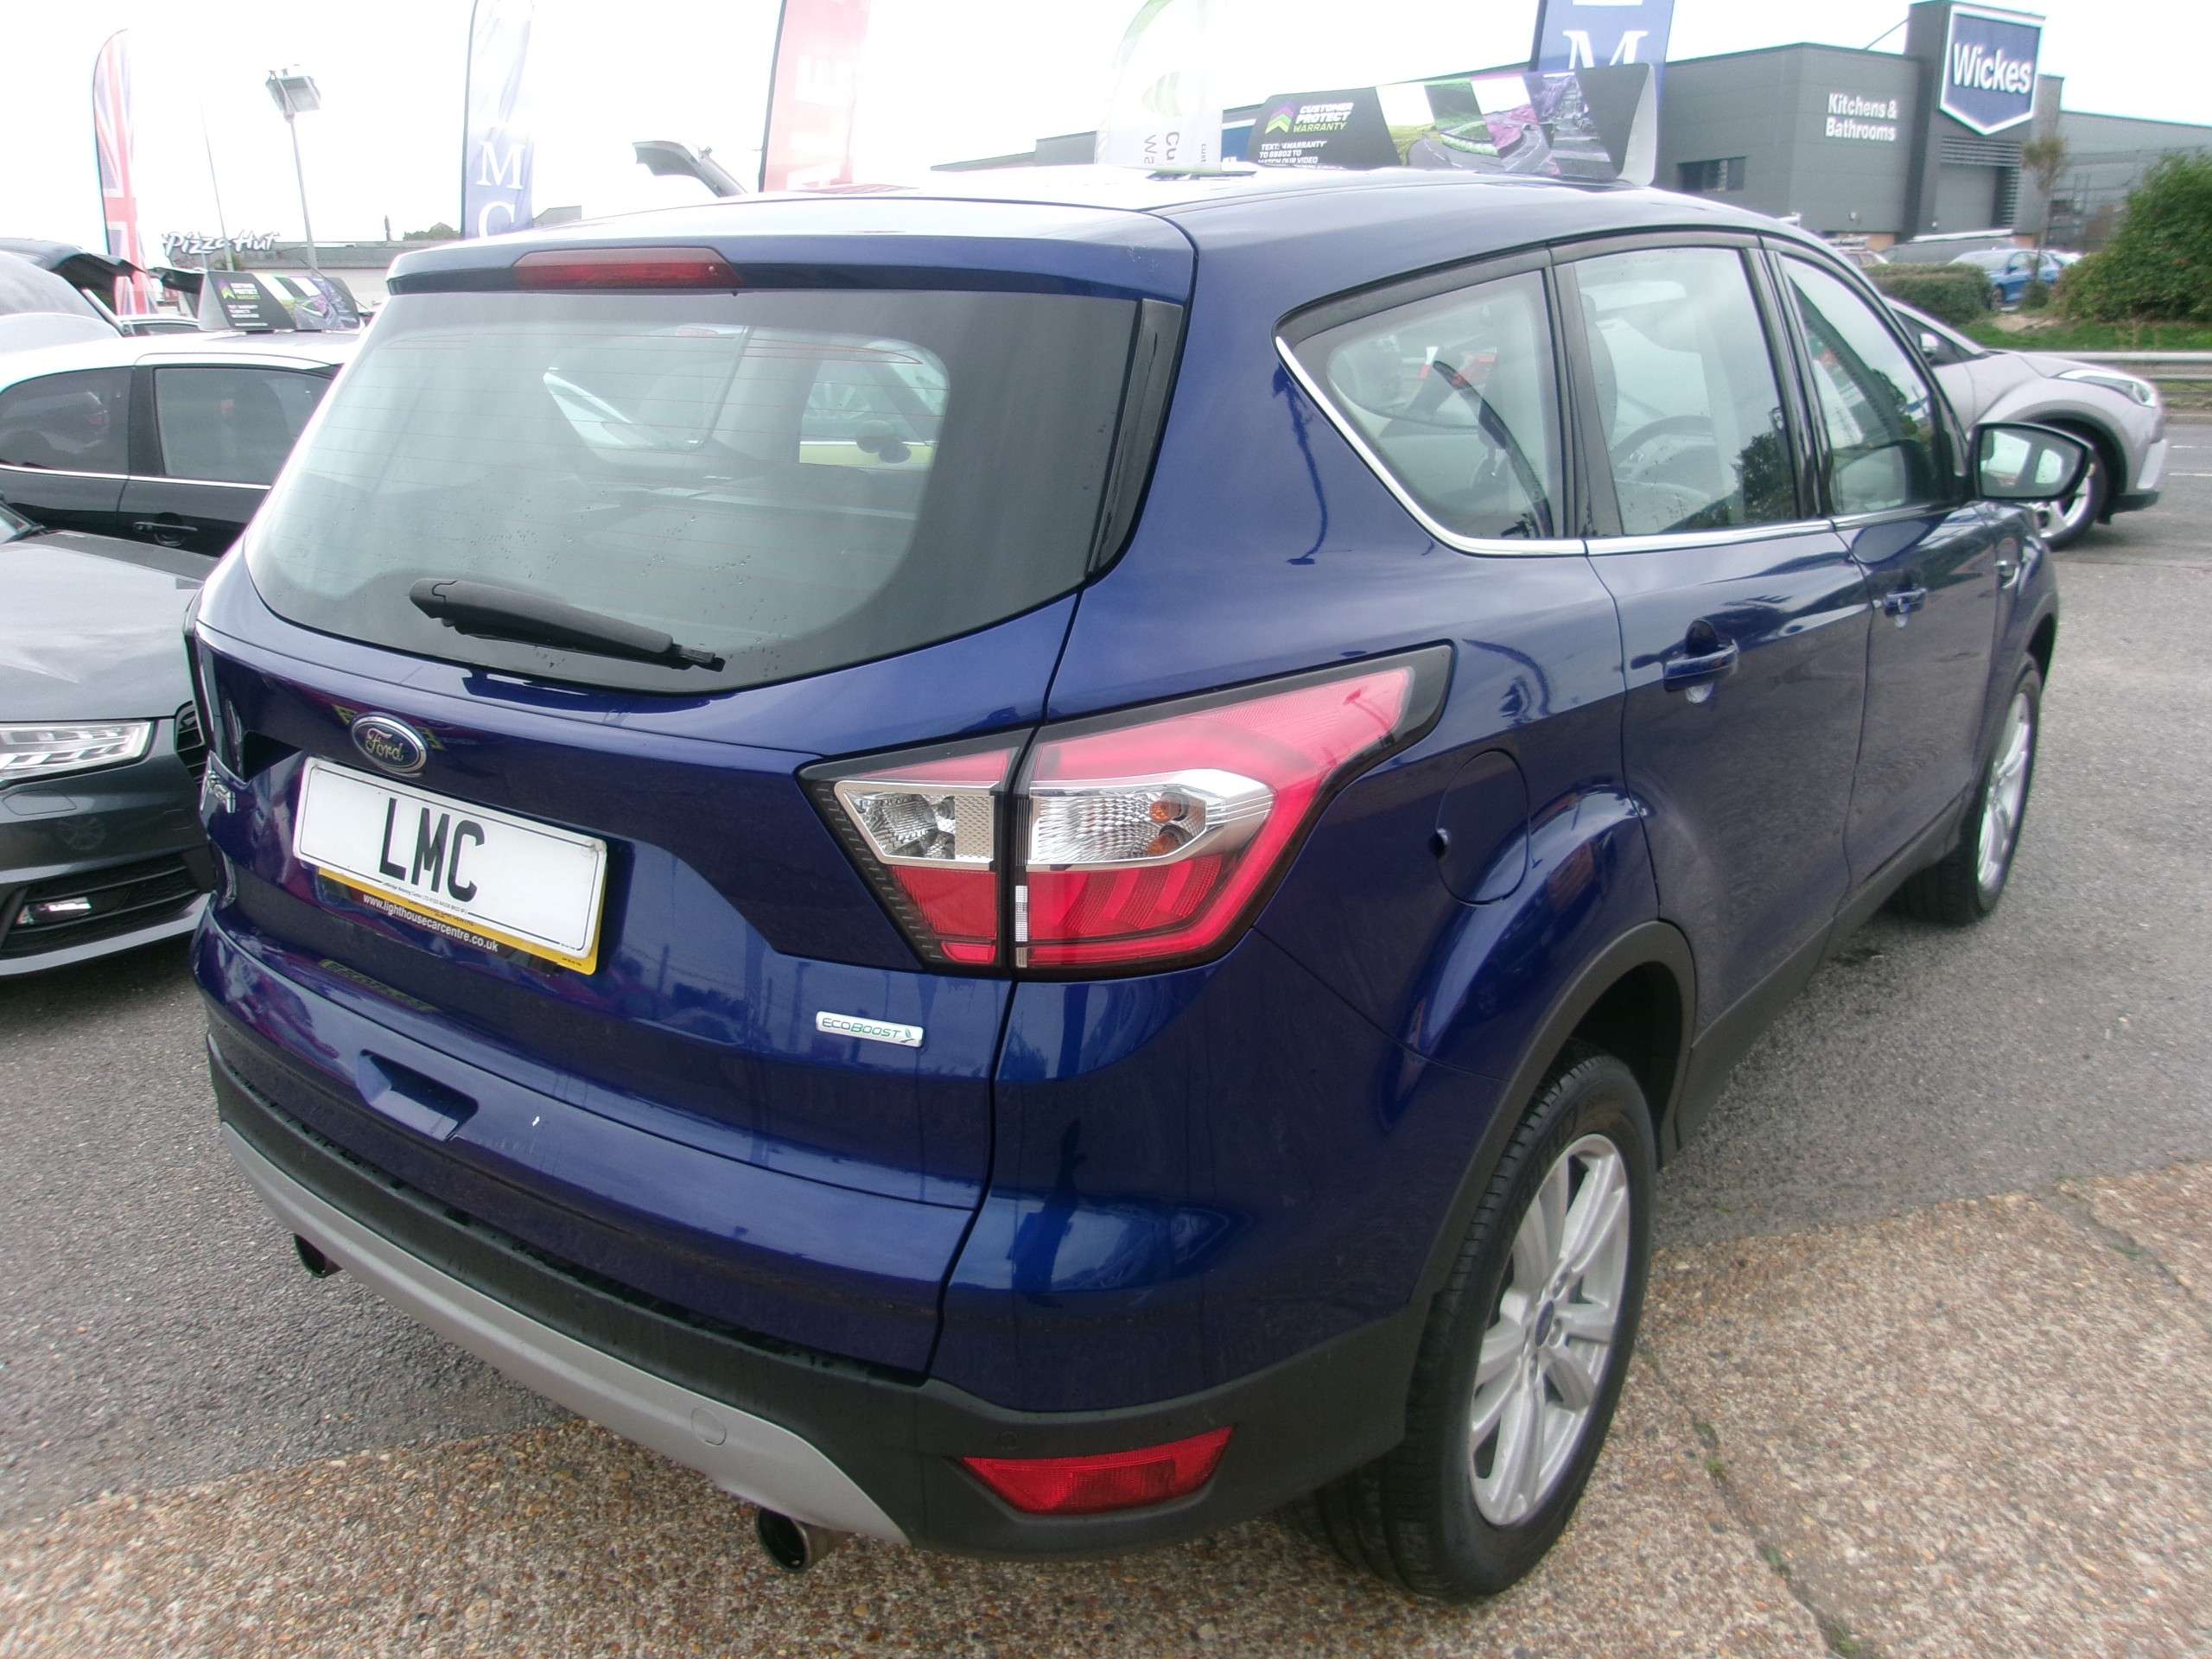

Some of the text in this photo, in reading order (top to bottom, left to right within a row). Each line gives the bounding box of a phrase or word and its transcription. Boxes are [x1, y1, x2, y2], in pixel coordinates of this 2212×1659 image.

[1954, 41, 2031, 94] Wickes
[1295, 111, 1351, 124] PROTECT
[1300, 102, 1354, 114] CUSTOMER
[1827, 93, 1897, 119] Kitchens &
[1293, 122, 1347, 133] WARRANTY
[1826, 117, 1895, 141] Bathrooms
[162, 229, 281, 257] Pizza Hut
[365, 728, 404, 761] Ford
[378, 797, 485, 902] LMC
[363, 893, 499, 953] www.lighthousecarcentre.co.uk
